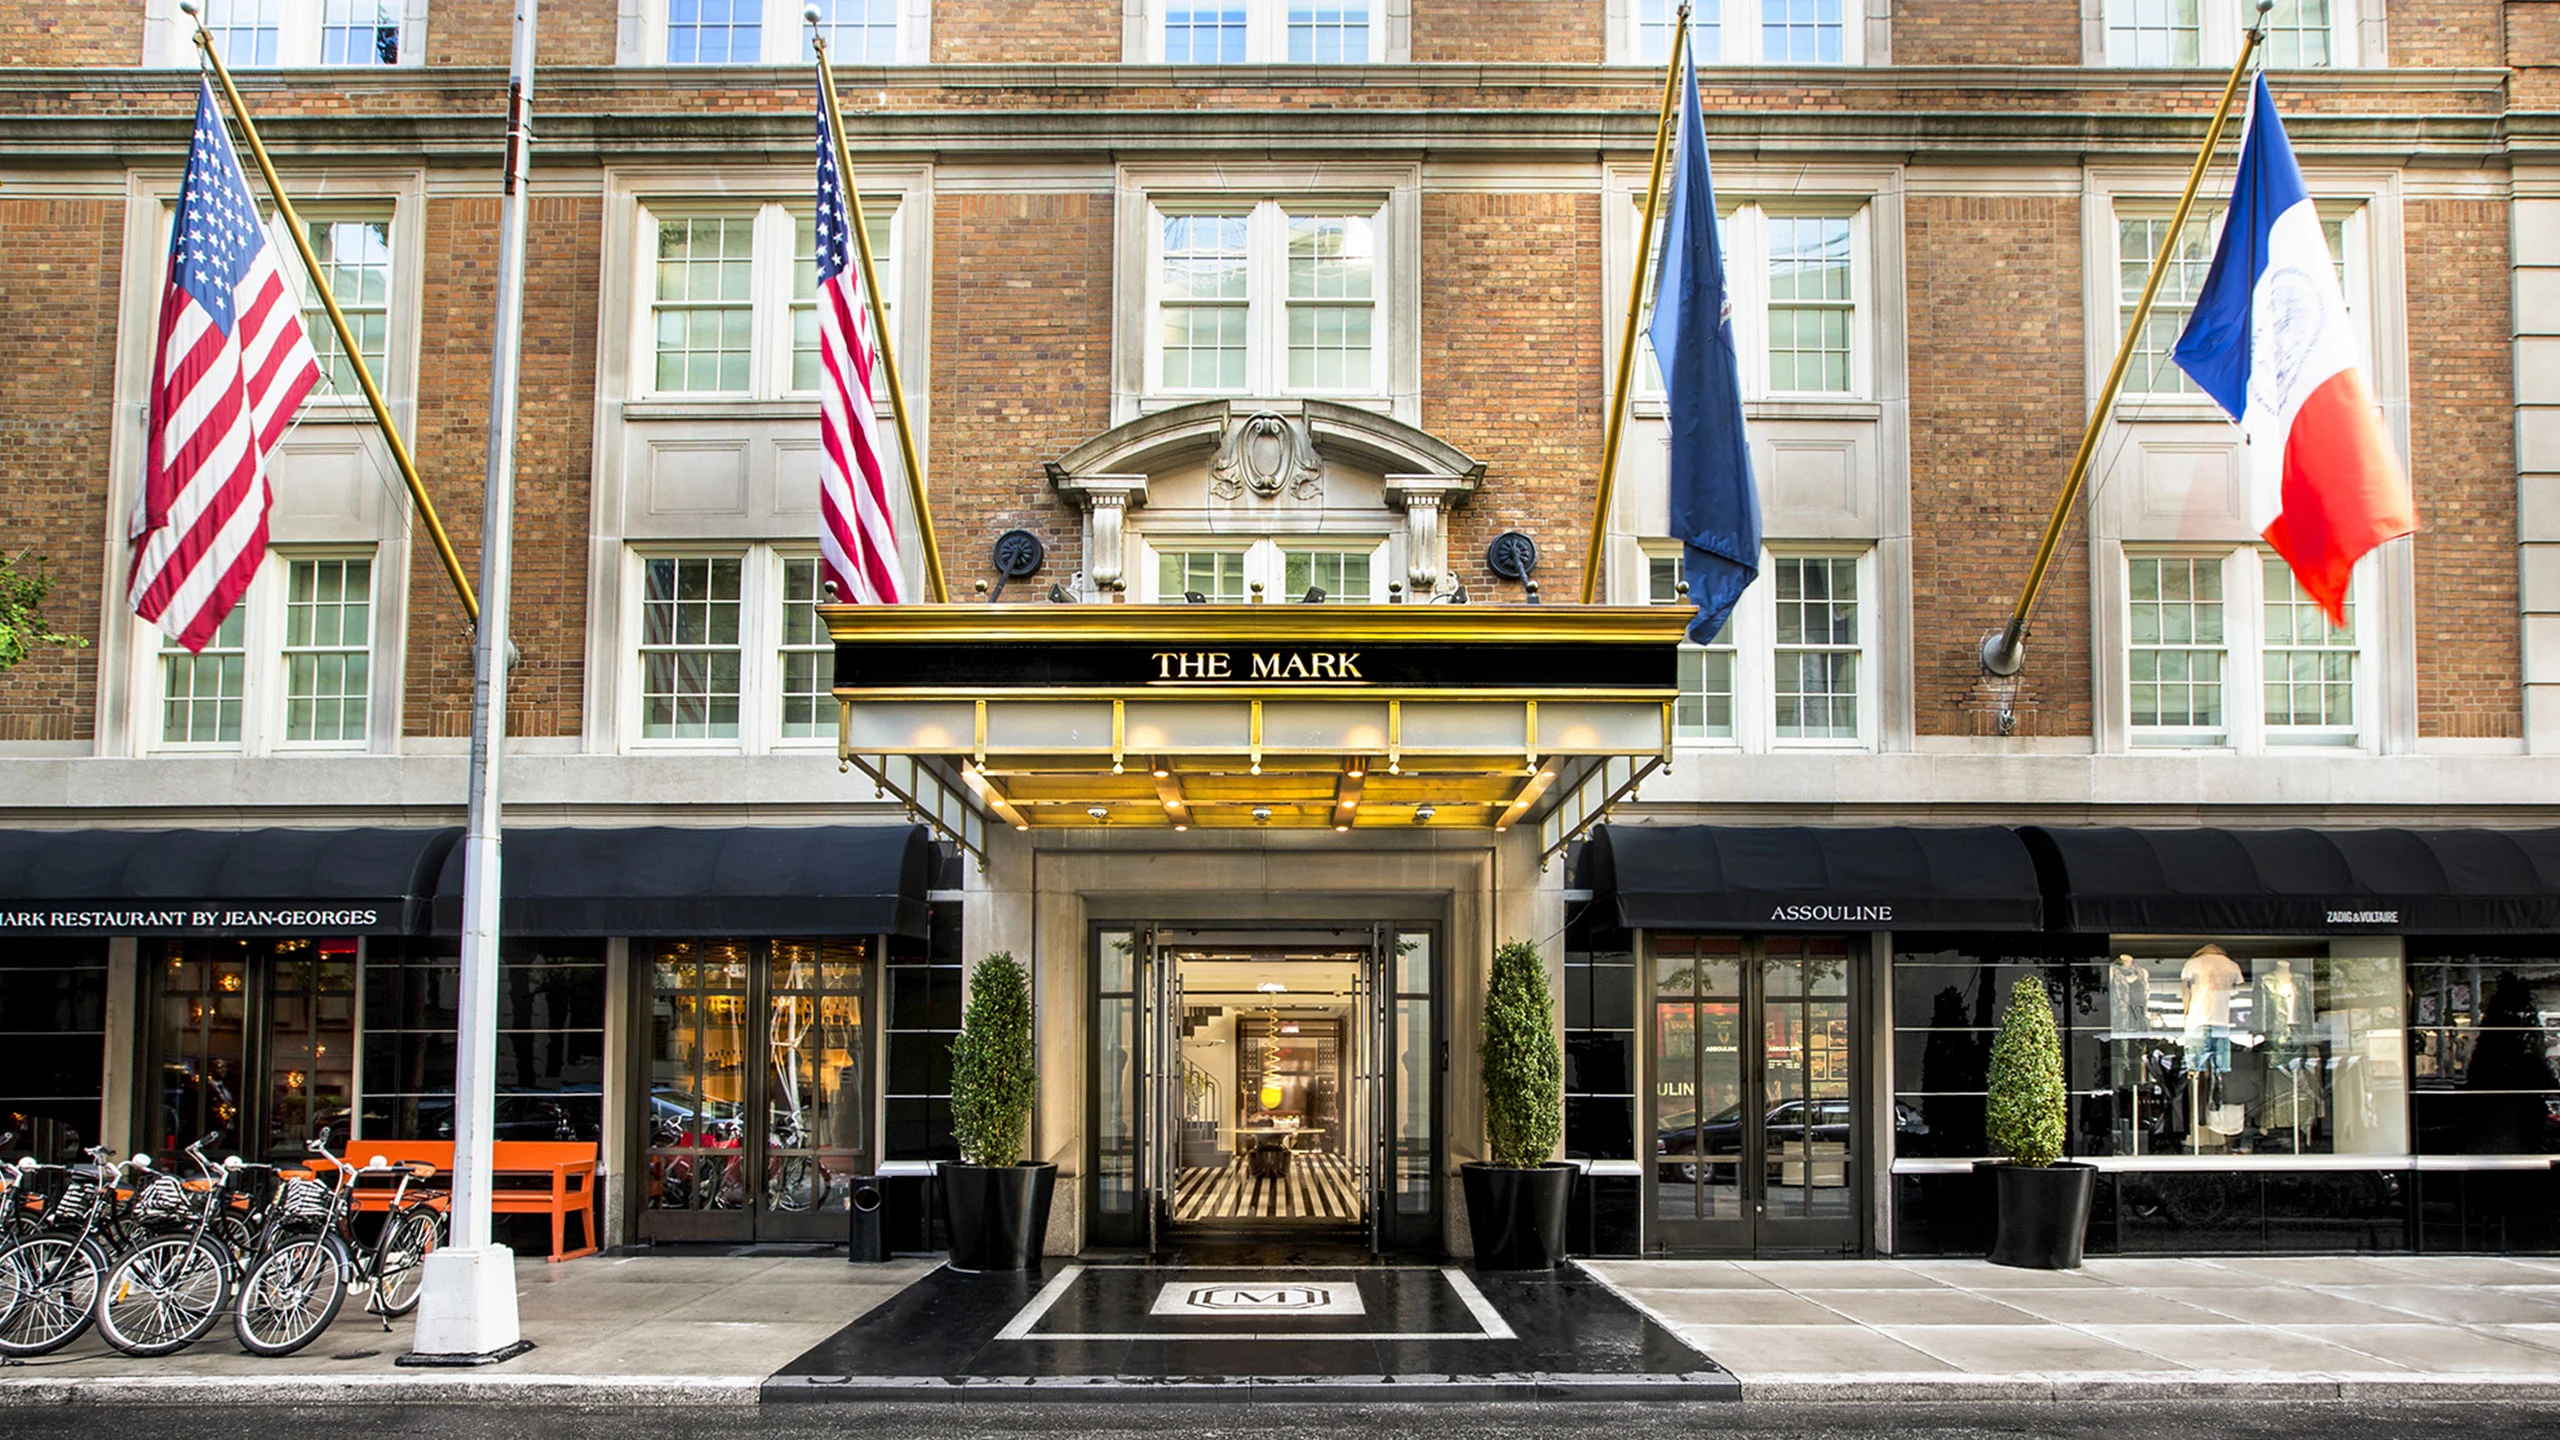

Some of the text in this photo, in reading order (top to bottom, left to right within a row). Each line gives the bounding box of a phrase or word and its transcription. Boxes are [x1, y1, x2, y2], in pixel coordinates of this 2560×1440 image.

[1151, 652, 1362, 678] THE MARK
[50, 911, 187, 926] RESTAURANT
[191, 911, 219, 926] BY
[221, 909, 377, 926] JEAN-GEORGES
[1770, 905, 1893, 921] ASSOULINE
